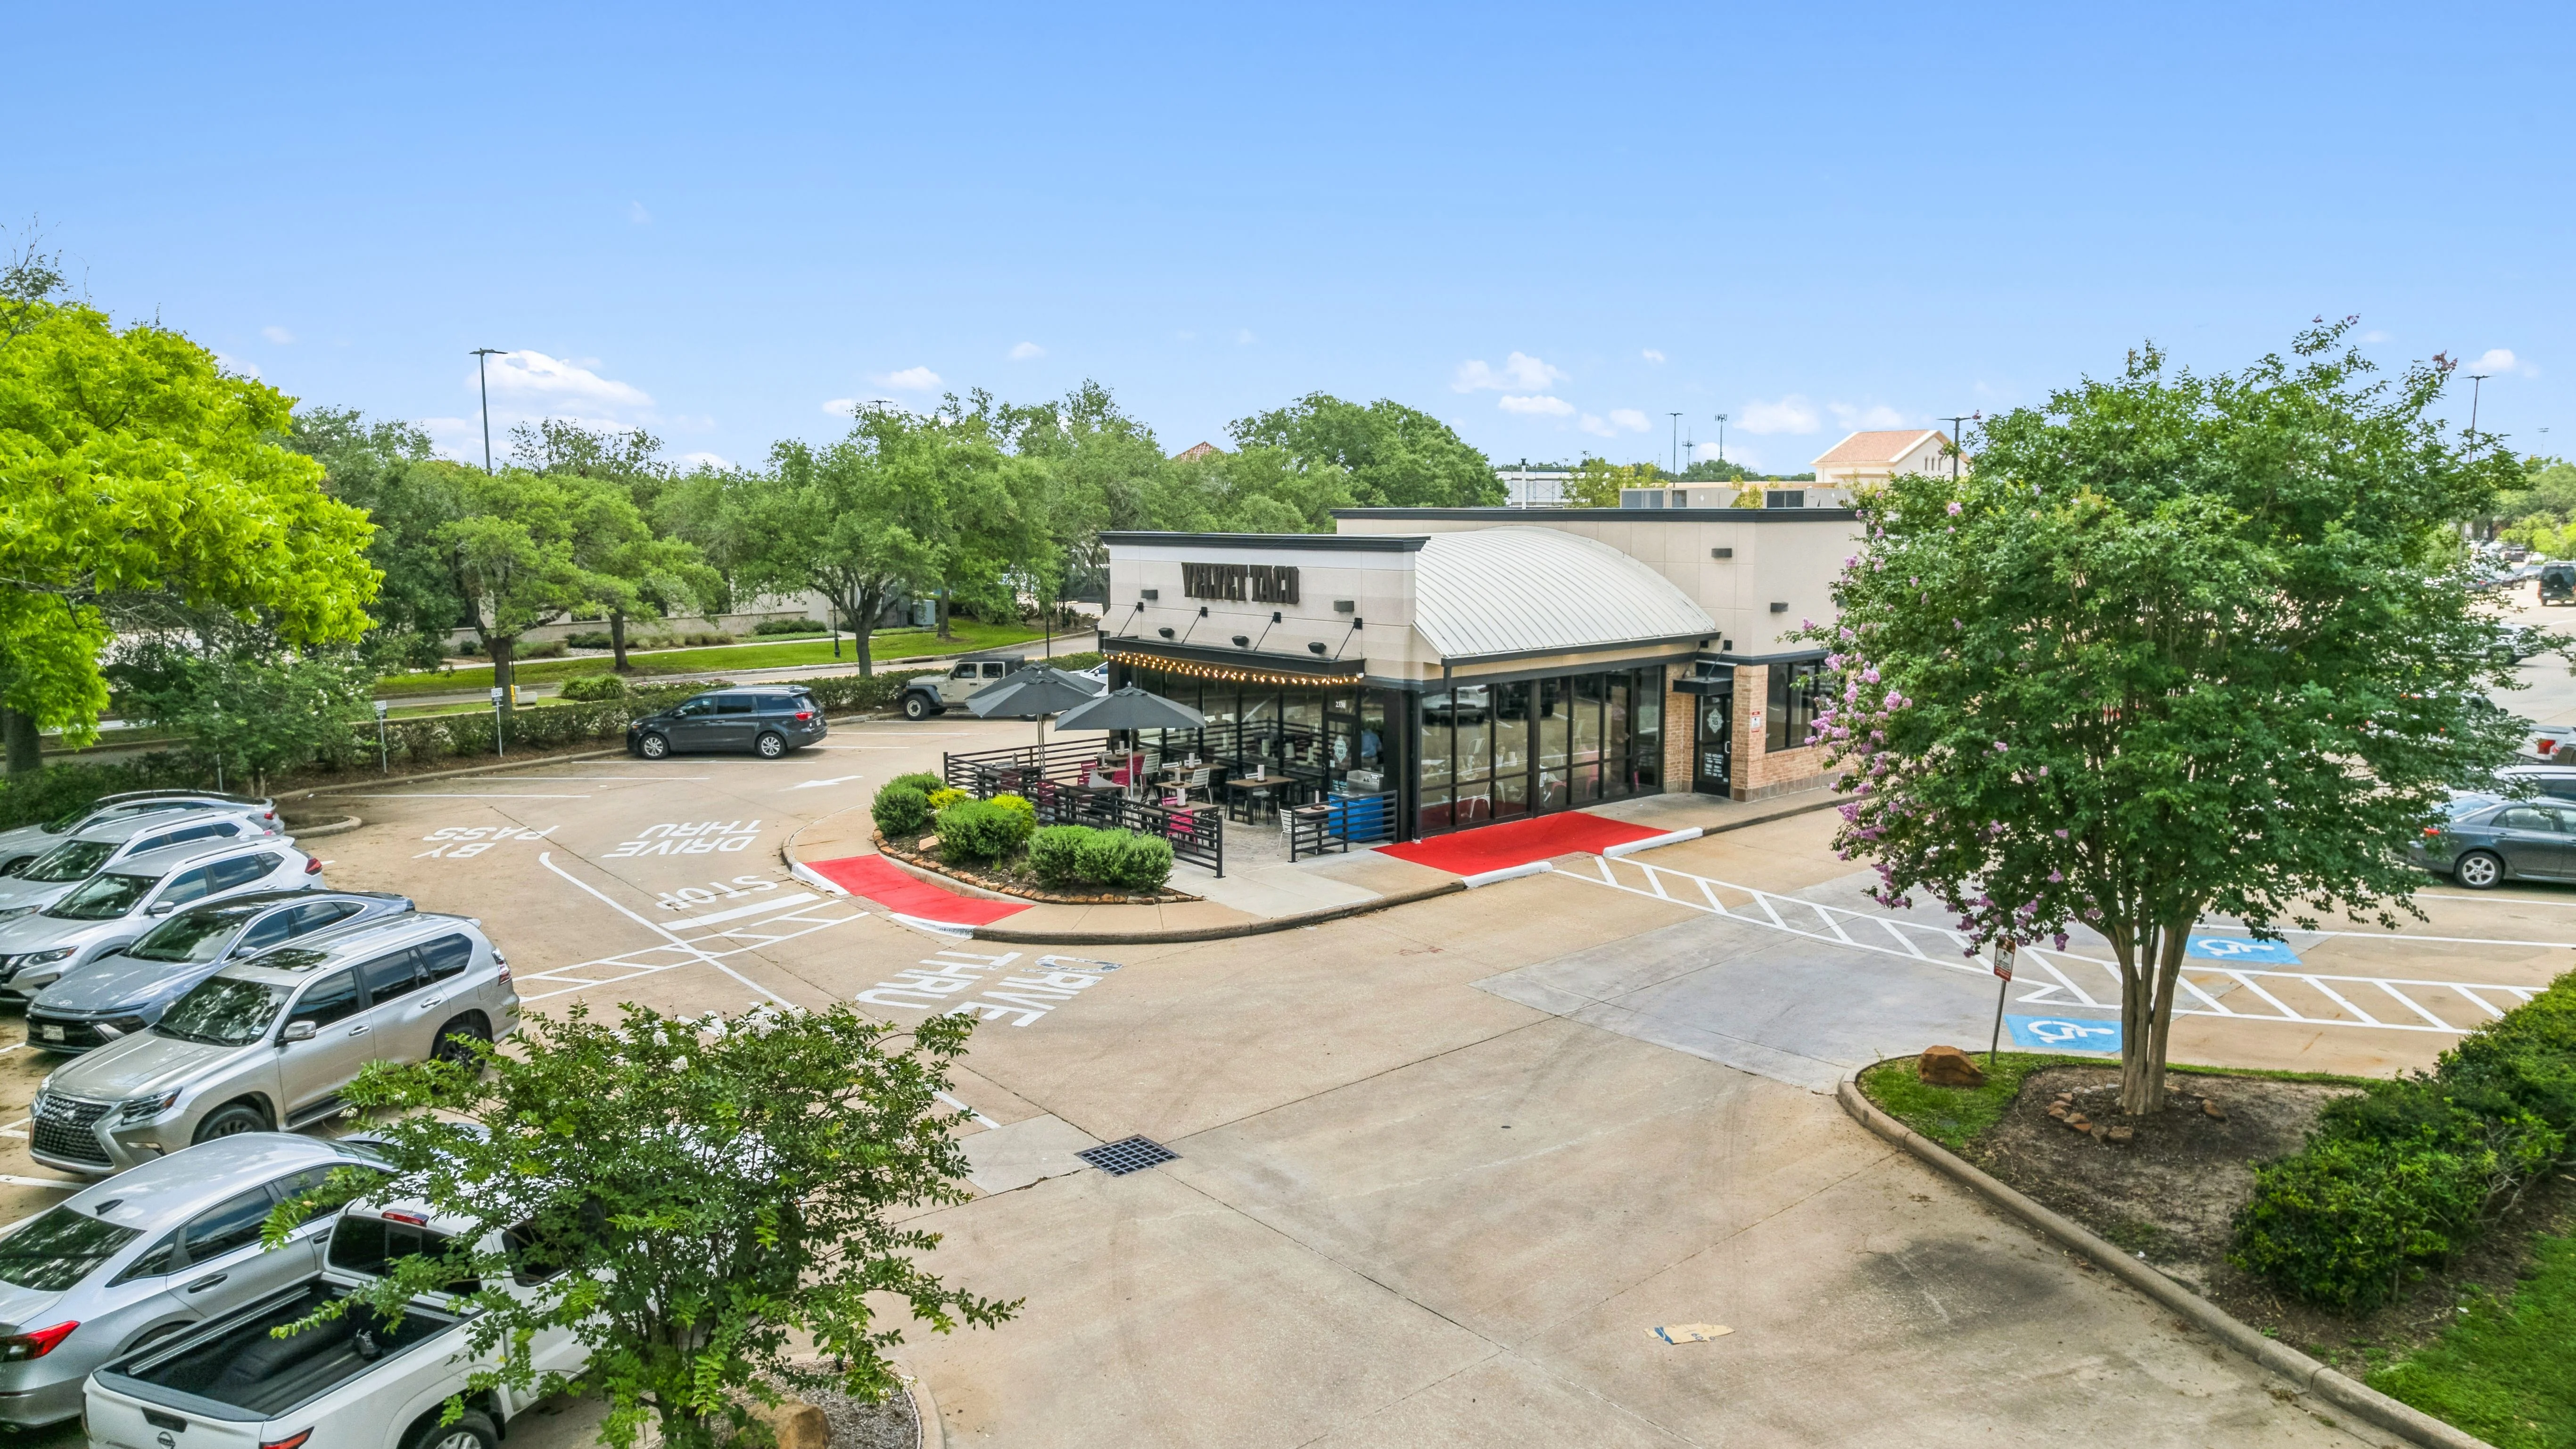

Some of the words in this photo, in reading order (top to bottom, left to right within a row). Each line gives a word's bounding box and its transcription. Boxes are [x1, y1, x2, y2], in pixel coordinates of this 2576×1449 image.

[1181, 562, 1248, 601] VELVET
[1249, 565, 1300, 604] TACO
[422, 825, 560, 840] PASS
[636, 820, 762, 838] THRU
[411, 843, 496, 858] BY
[601, 836, 756, 858] DRIVE
[655, 875, 778, 910] STOP
[855, 951, 1023, 1009] THRU
[943, 955, 1123, 1027] DRIVE
